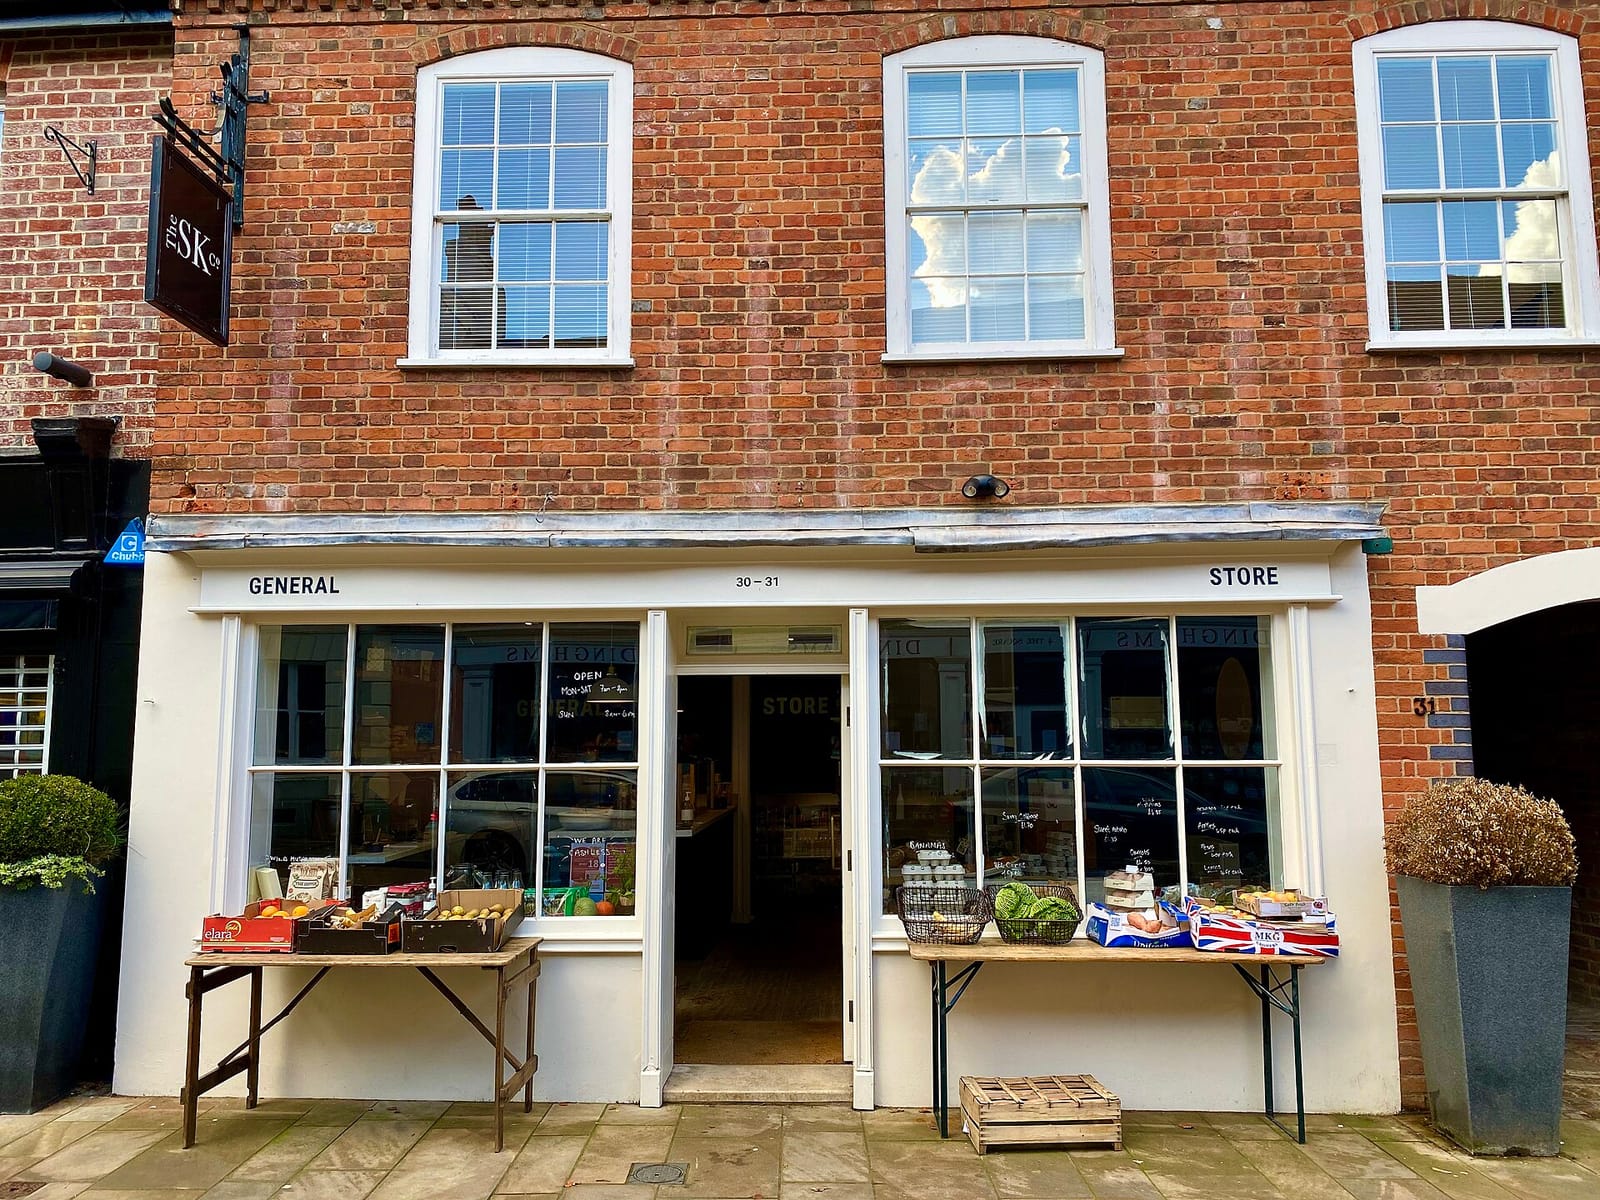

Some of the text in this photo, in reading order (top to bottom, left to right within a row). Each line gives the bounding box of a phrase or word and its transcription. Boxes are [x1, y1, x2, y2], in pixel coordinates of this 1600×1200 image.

[166, 214, 178, 250] The
[177, 218, 212, 276] SK
[111, 551, 145, 561] Chubb
[1209, 566, 1279, 586] STORE
[249, 576, 340, 595] GENERAL
[573, 671, 602, 681] OPEN
[762, 697, 829, 715] STORE
[1413, 697, 1436, 717] 31
[557, 710, 575, 719] SUN
[591, 837, 607, 845] ARE
[588, 860, 599, 868] 18
[204, 927, 233, 940] elara
[1254, 931, 1281, 941] MKG
